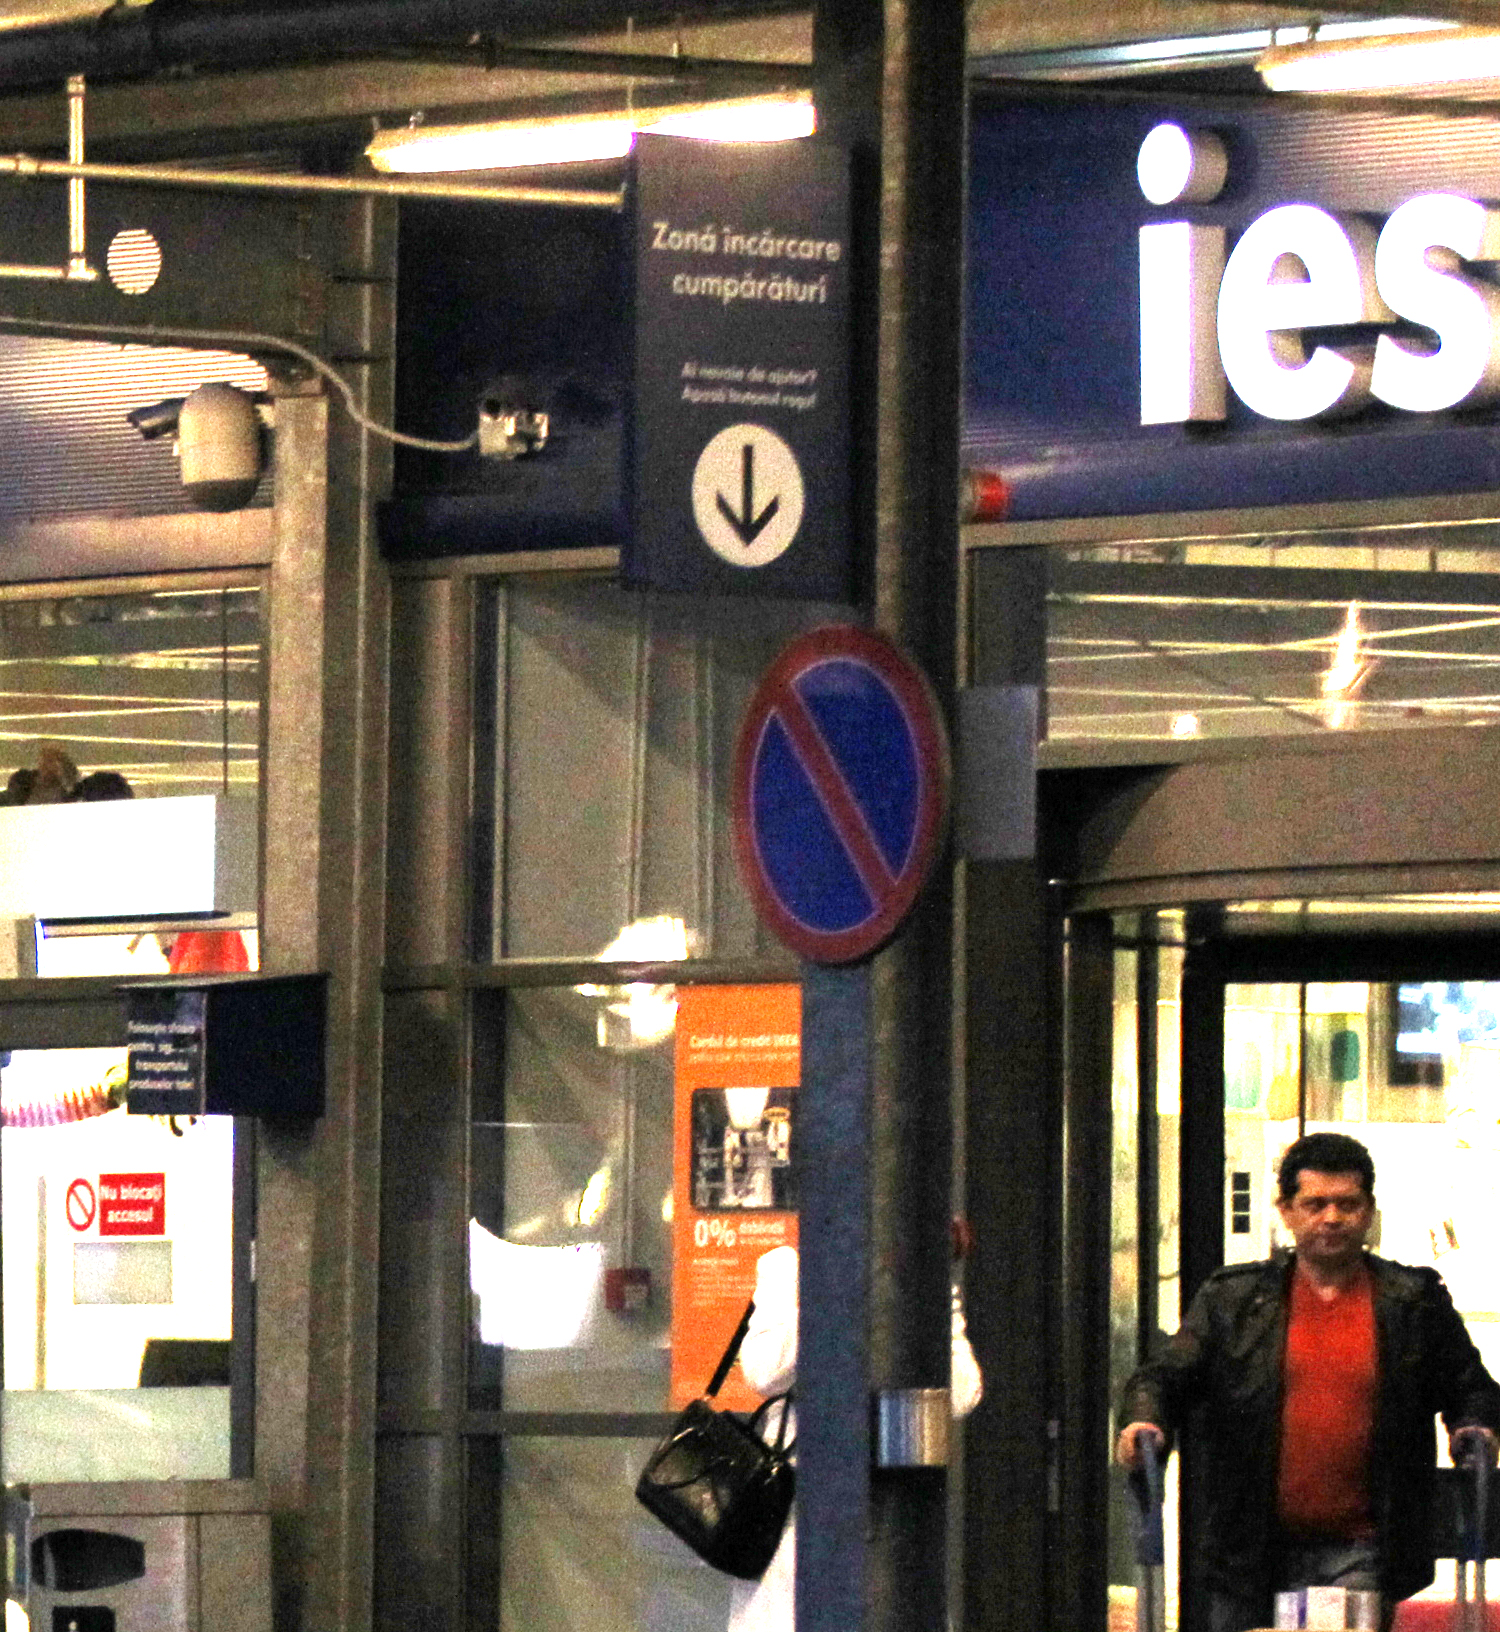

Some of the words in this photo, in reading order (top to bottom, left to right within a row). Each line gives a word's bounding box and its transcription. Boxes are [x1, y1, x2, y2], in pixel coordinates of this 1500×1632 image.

[100, 1185, 117, 1200] Nu
[107, 1207, 153, 1223] accesul
[694, 1219, 737, 1247] 0%
